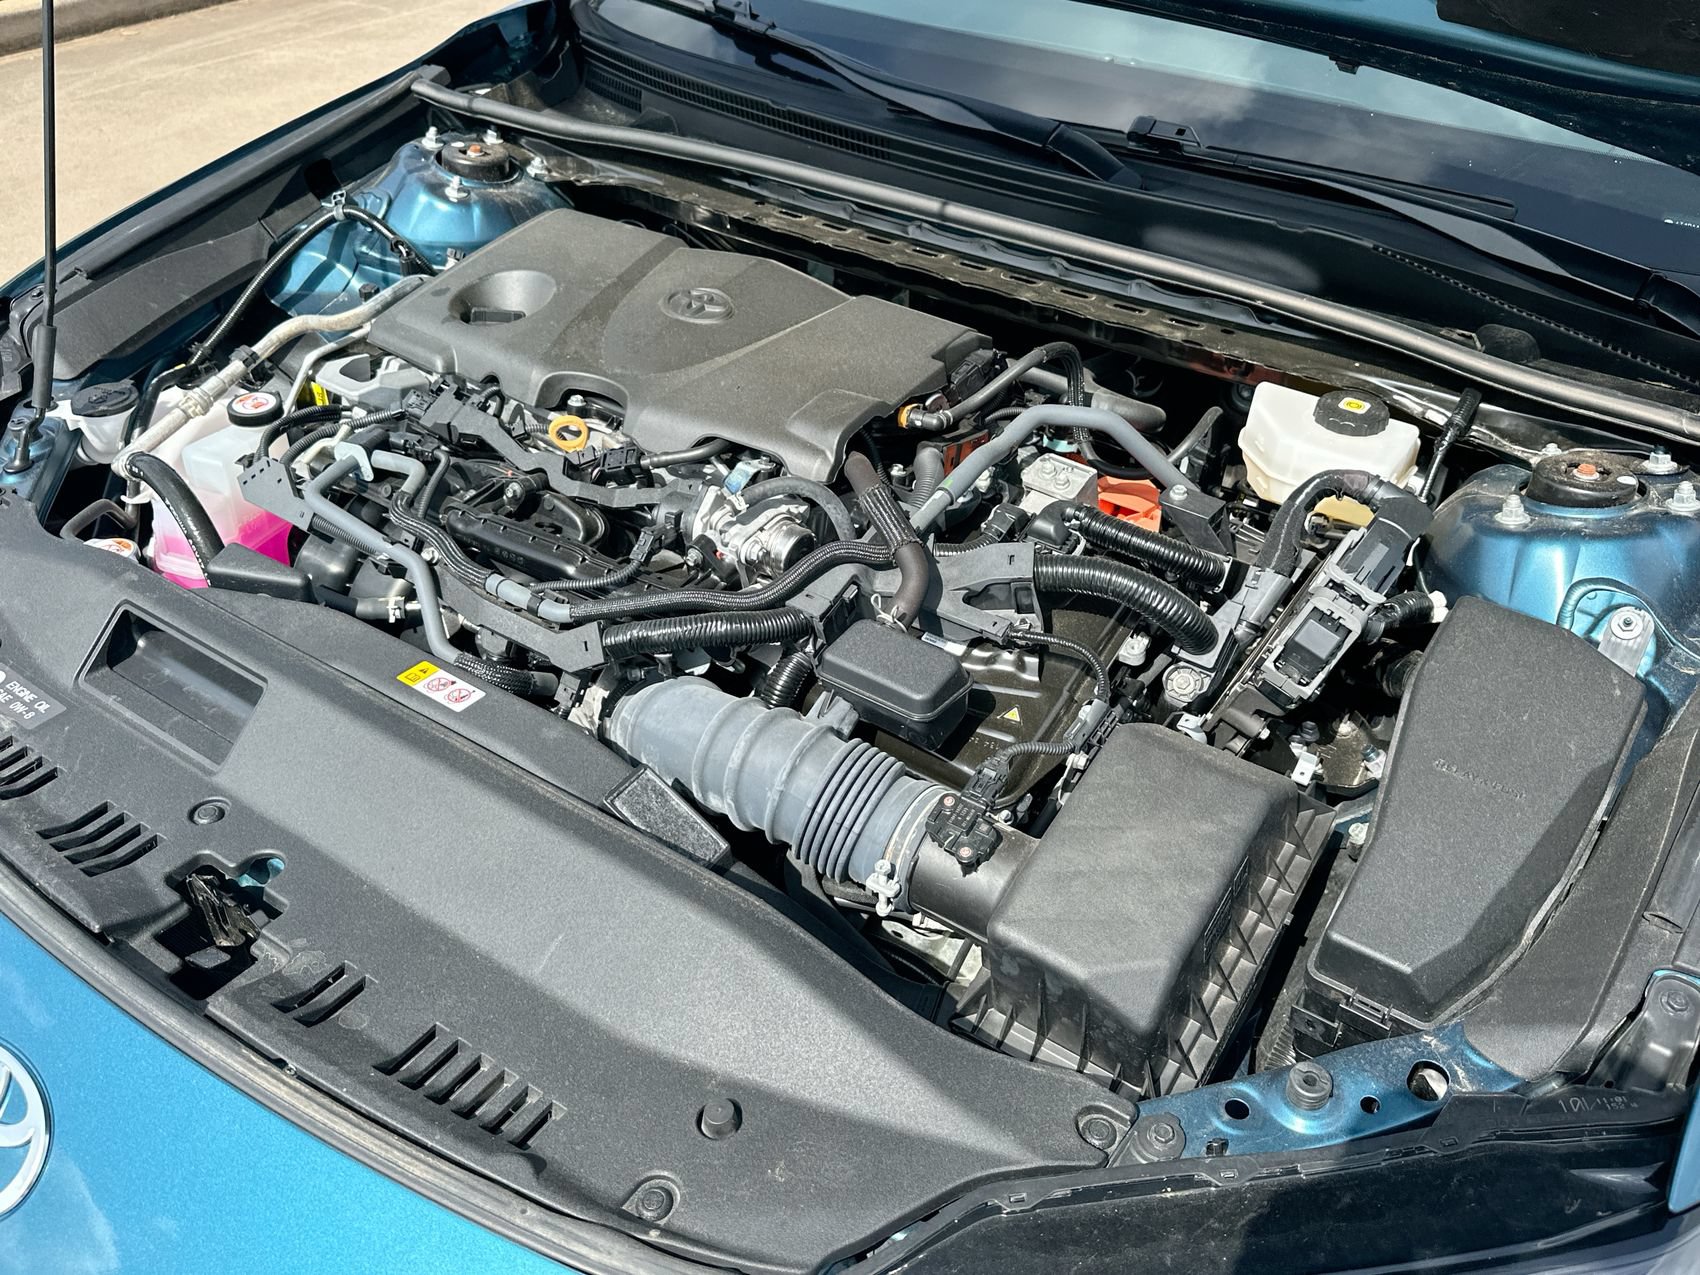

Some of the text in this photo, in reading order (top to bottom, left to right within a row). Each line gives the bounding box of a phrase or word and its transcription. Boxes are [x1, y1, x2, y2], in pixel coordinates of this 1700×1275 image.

[5, 681, 51, 714] ENGINE OIL
[9, 701, 36, 720] 0W-8
